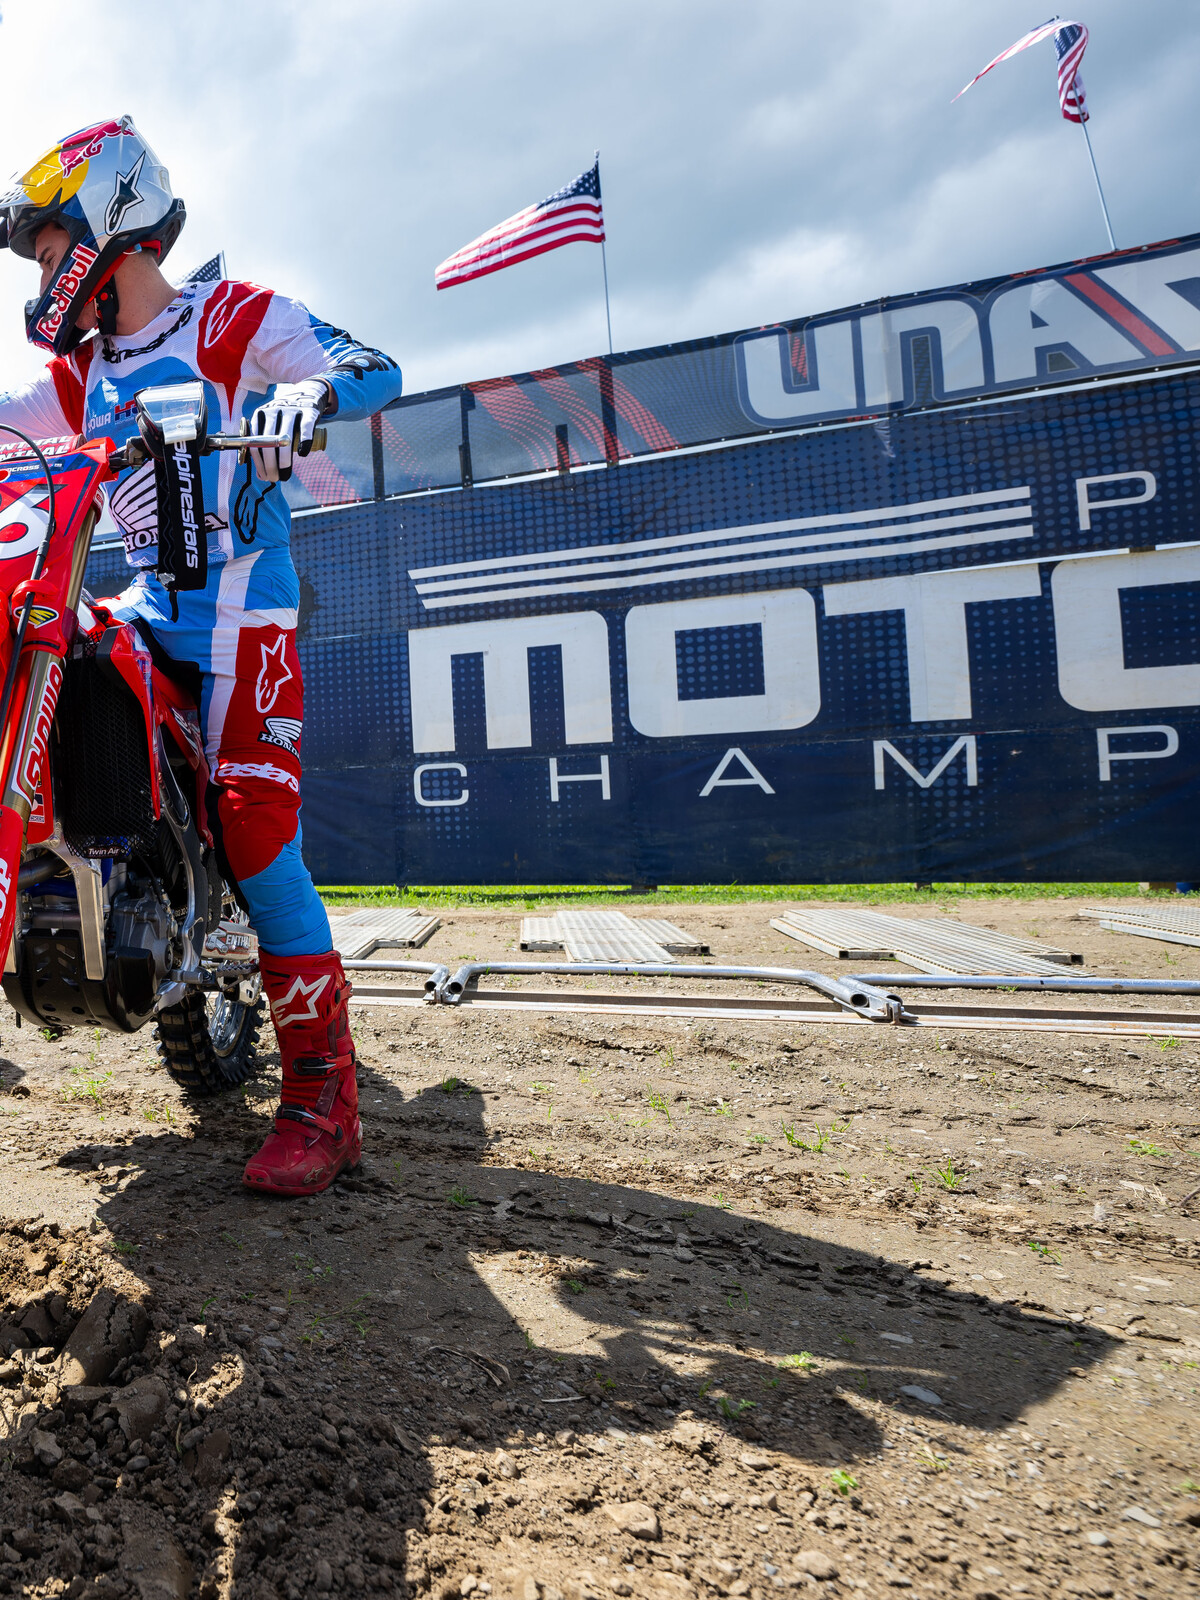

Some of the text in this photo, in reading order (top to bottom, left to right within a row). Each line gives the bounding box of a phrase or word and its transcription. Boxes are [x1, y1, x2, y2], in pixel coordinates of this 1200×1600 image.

[102, 304, 193, 364] inestars
[173, 440, 199, 569] alpinestars
[1075, 471, 1157, 531] P
[122, 512, 229, 554] HOA
[217, 762, 299, 793] astars
[413, 724, 1179, 807] CHAMP
[88, 848, 120, 856] Twin Air
[225, 934, 251, 949] ENTH
